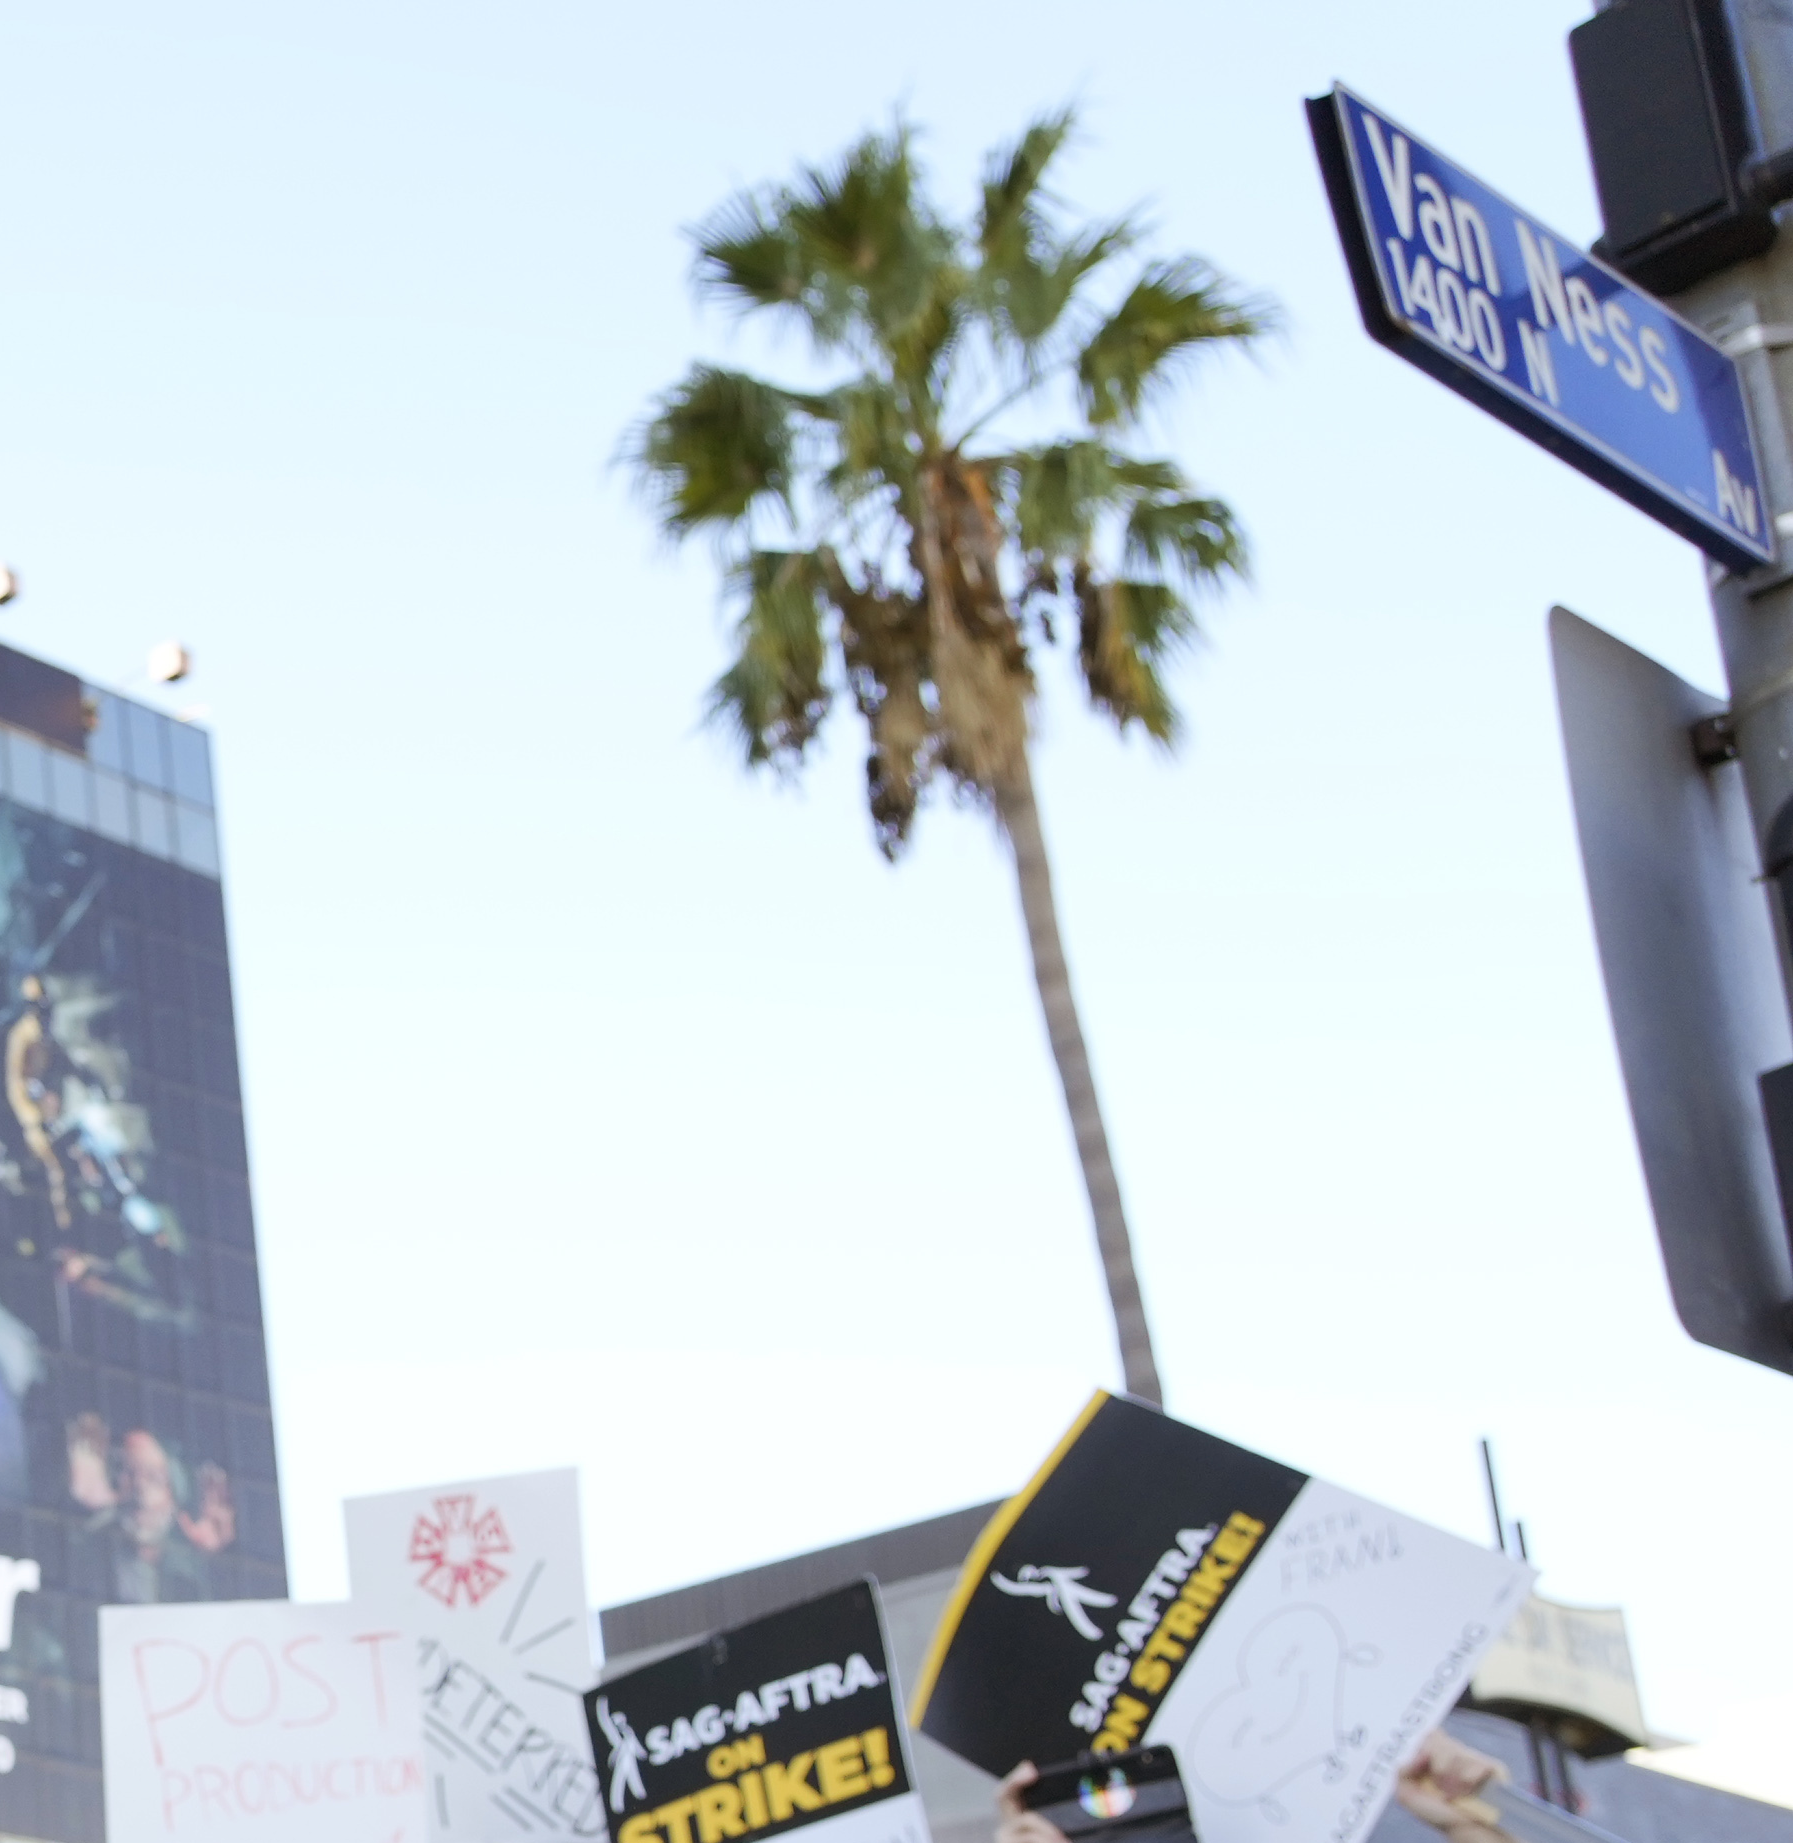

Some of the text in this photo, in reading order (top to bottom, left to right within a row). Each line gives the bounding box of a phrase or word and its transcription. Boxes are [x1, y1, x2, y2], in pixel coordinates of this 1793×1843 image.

[1361, 111, 1680, 414] Van Ness
[1386, 236, 1560, 408] 1400 N
[1129, 1508, 1267, 1697] STRIKE!
[130, 1629, 405, 1769] POST
[705, 1732, 767, 1780] ON
